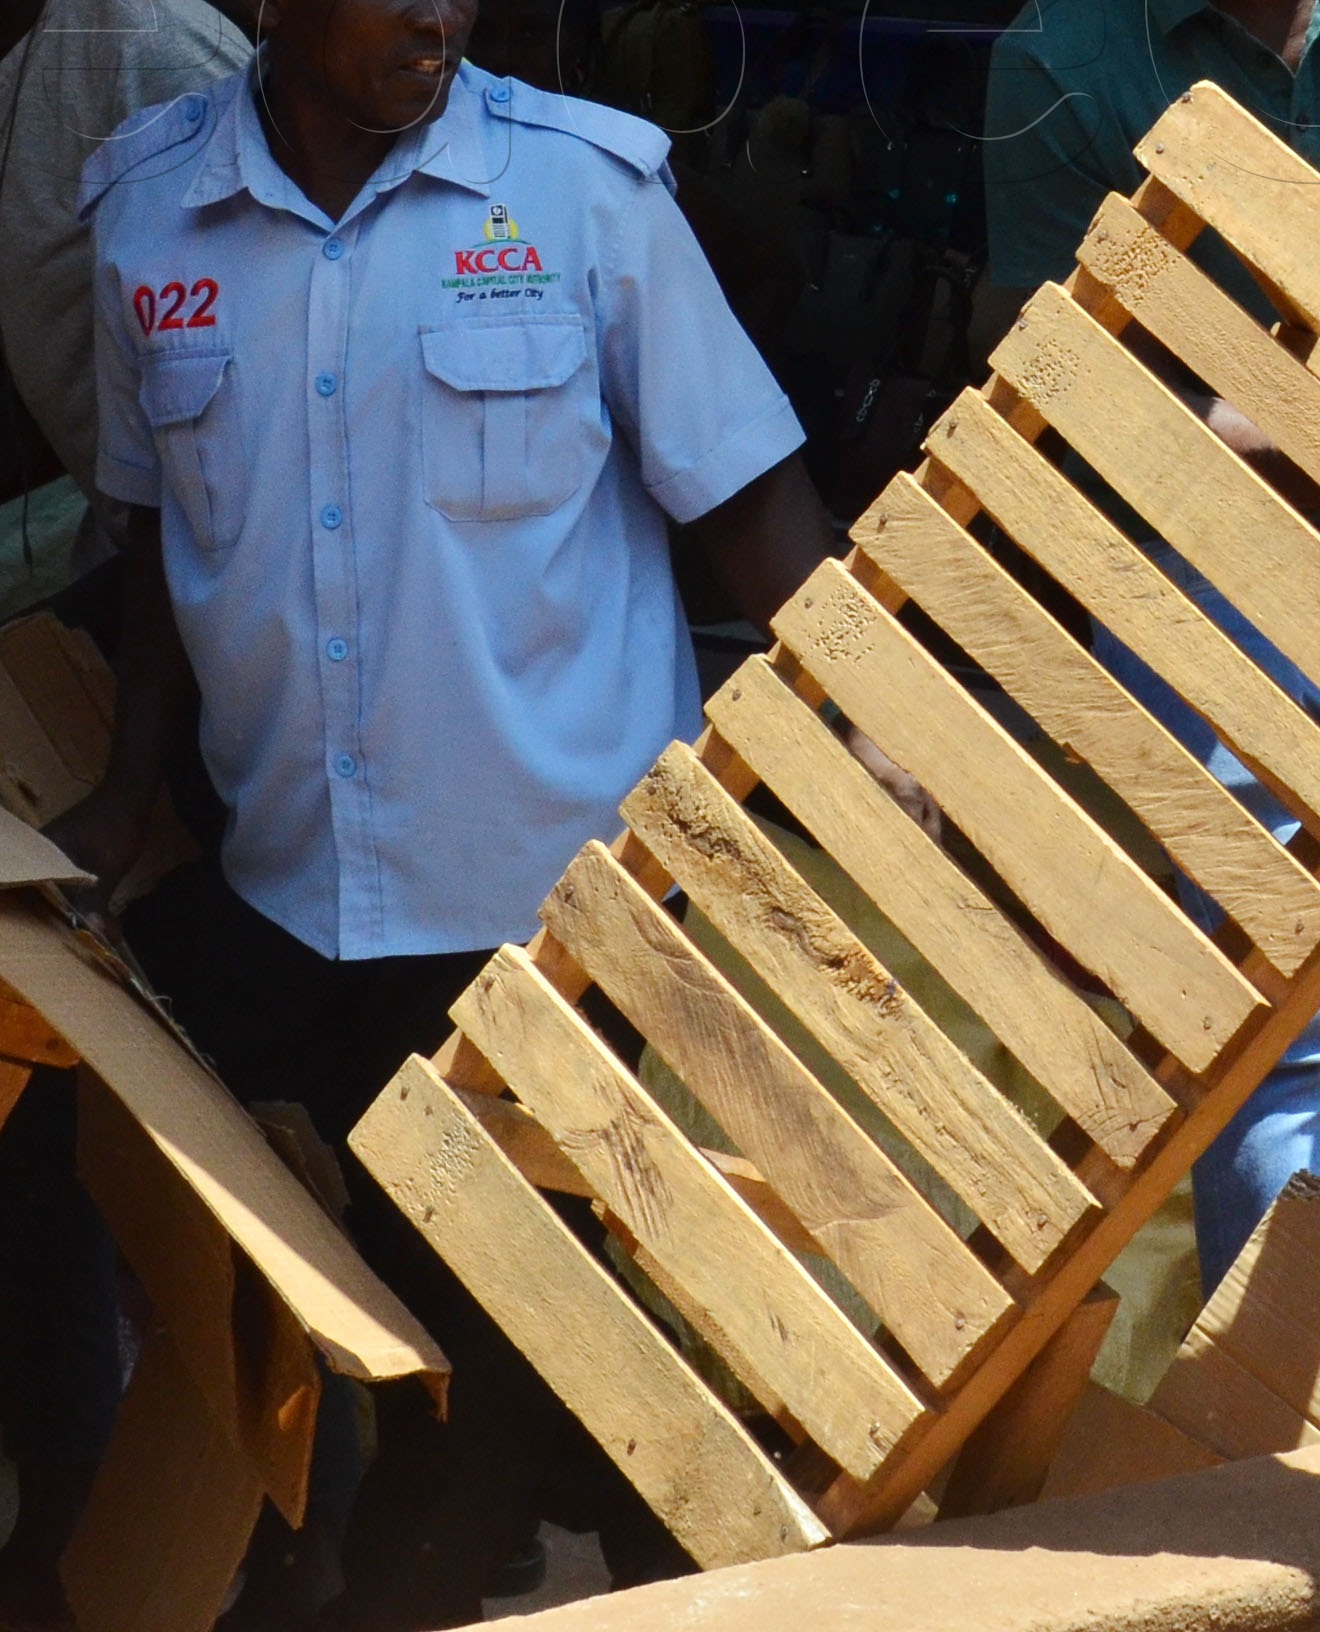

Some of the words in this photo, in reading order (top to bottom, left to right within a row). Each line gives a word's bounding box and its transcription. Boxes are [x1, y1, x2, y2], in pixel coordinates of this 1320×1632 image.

[454, 246, 544, 275] KCCA
[133, 277, 219, 337] 022
[456, 290, 476, 304] For
[479, 292, 487, 300] a
[490, 287, 523, 300] better
[524, 288, 544, 301] City
